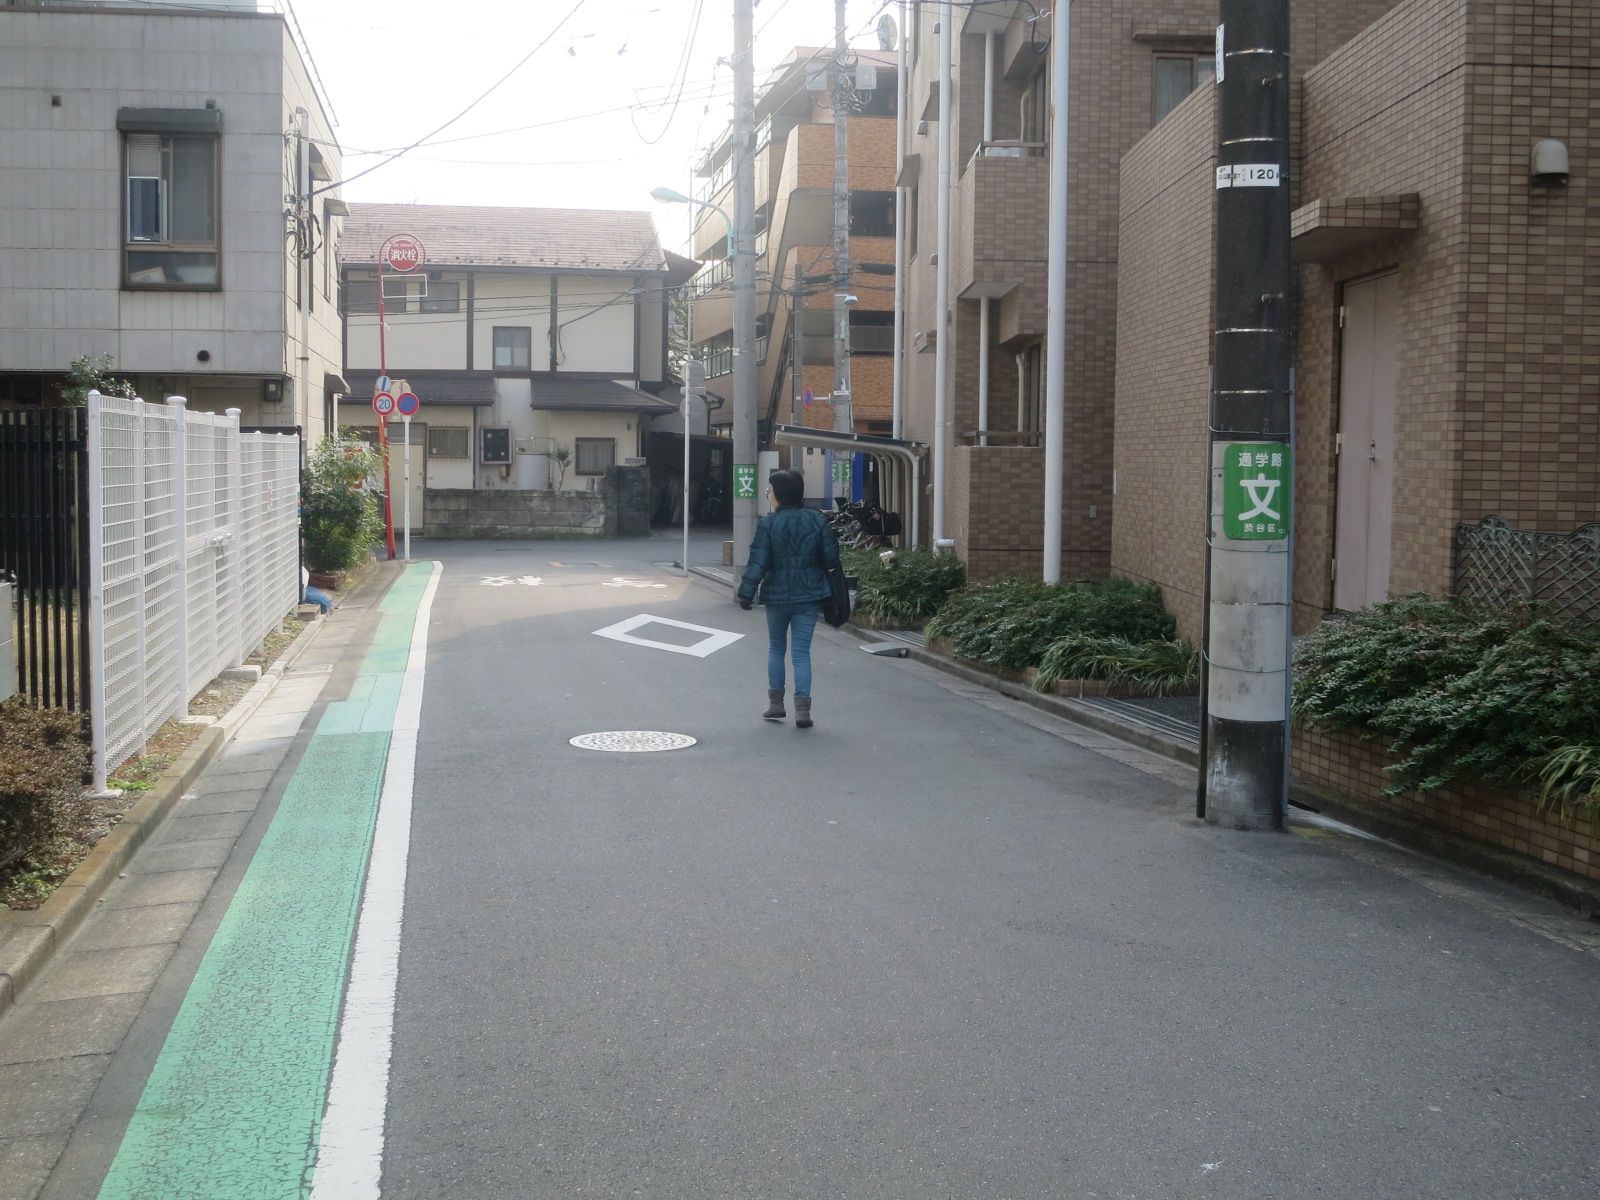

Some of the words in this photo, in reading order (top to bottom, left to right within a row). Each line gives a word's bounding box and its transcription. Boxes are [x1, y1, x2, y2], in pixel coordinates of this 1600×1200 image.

[1250, 169, 1274, 180] 120
[390, 249, 417, 261] 消火栓
[378, 399, 391, 409] 20
[1238, 452, 1282, 467] 通学路
[738, 475, 754, 493] 文
[1238, 472, 1281, 521] 文
[1243, 523, 1276, 533] 渋谷区
